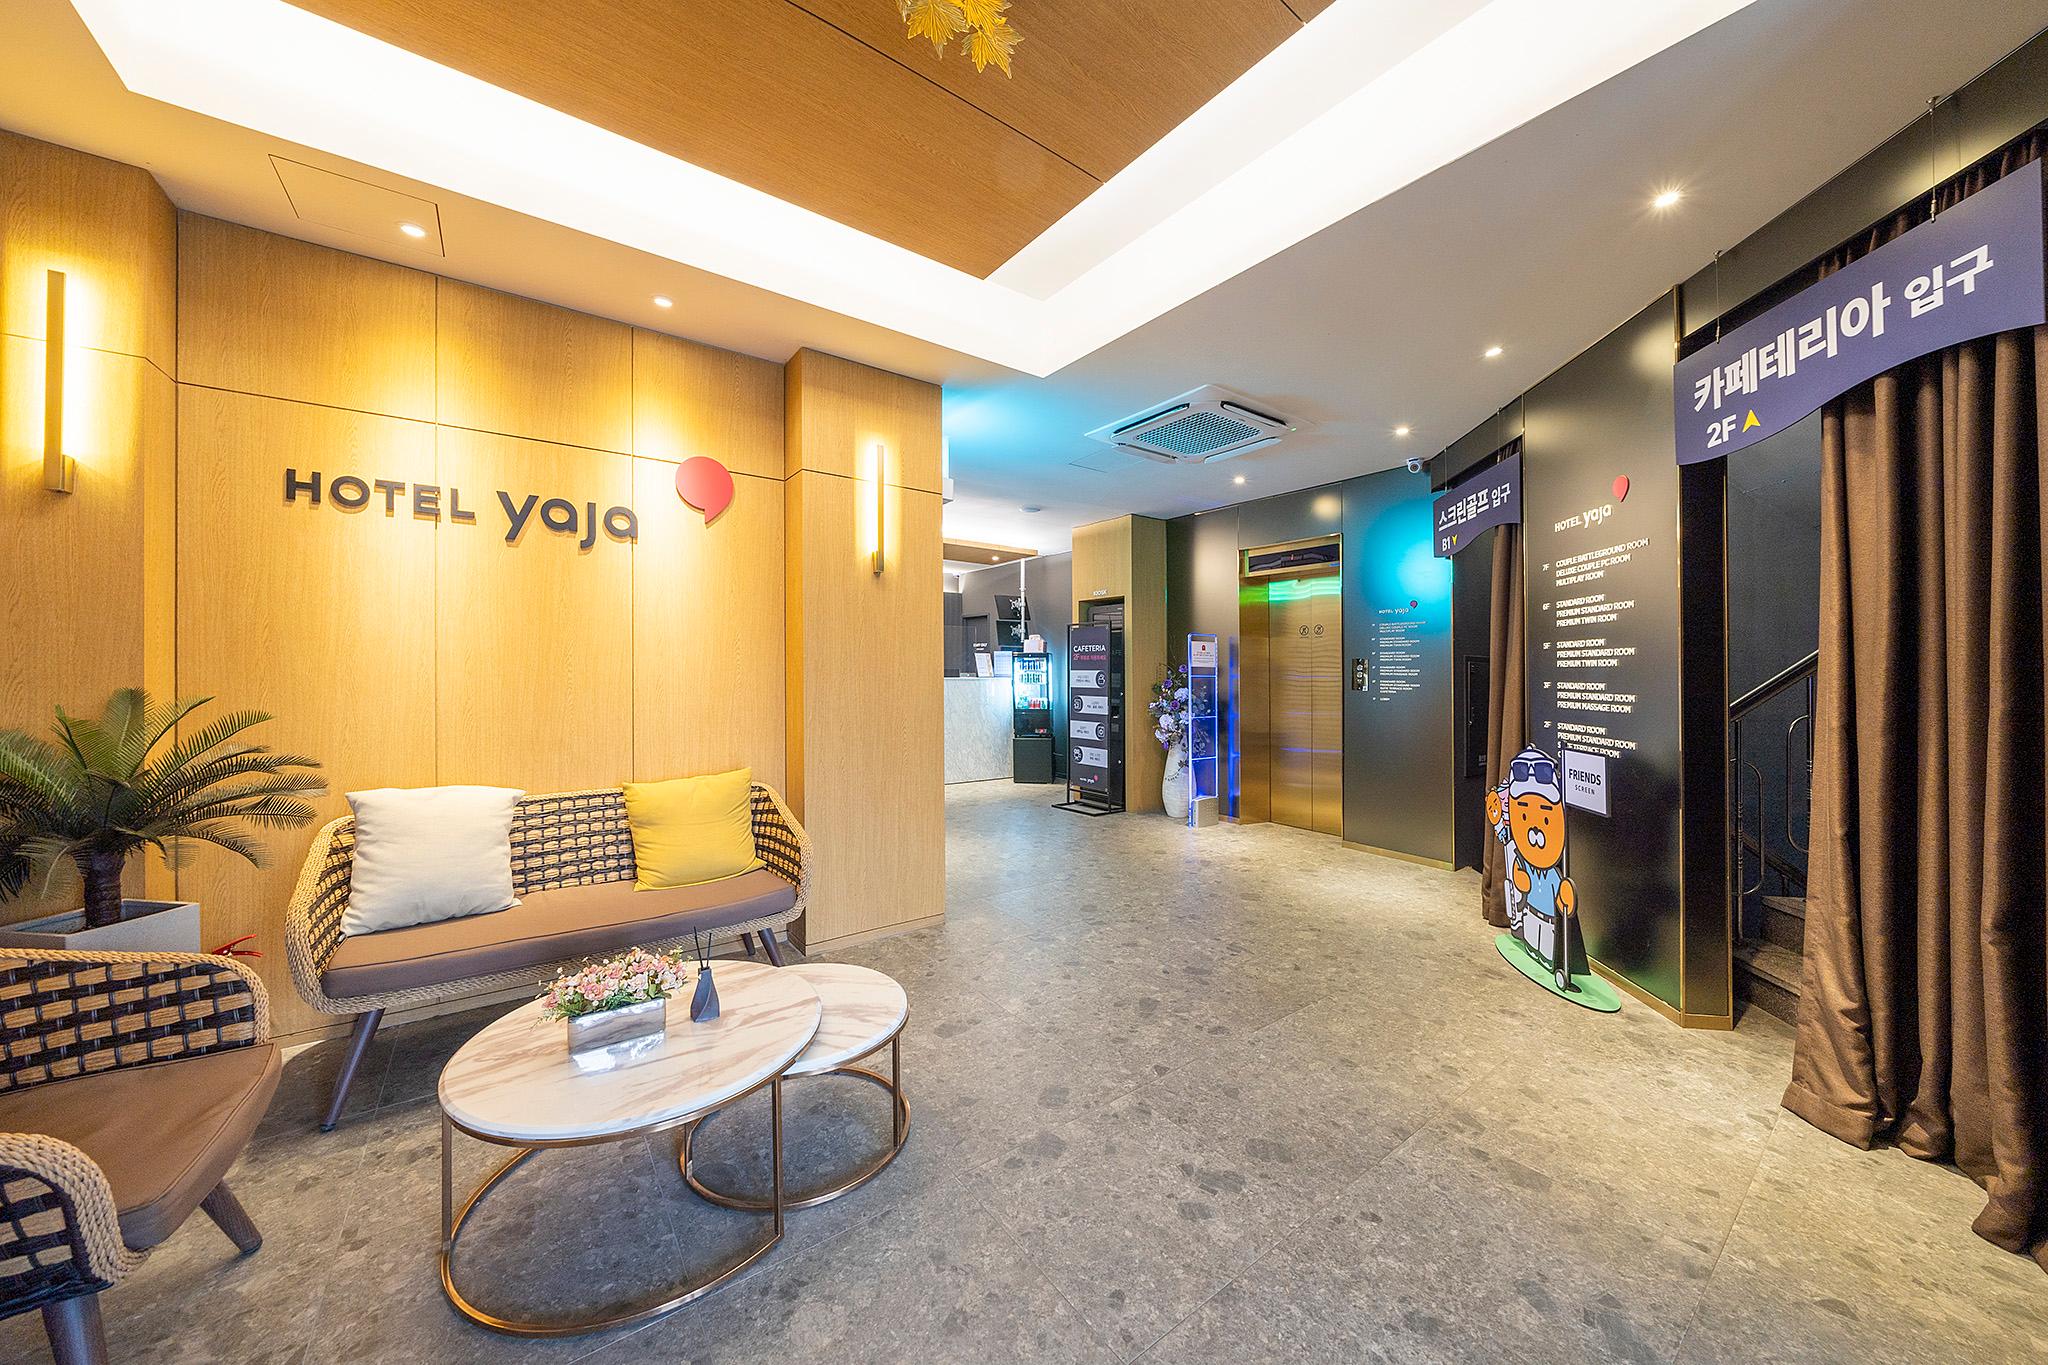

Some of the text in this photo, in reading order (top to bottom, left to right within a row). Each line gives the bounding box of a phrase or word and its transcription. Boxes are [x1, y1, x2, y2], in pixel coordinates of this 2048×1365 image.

[1693, 244, 1994, 413] 카페테리아 입구
[1706, 414, 1737, 449] 2F
[285, 468, 639, 550] HOTEL yaja
[1438, 482, 1511, 532] 스크린골프 입구
[1554, 504, 1613, 533] HOTEL yaja
[1442, 536, 1451, 552] B1
[1555, 537, 1650, 568] COUPLE BATTLEGROUND ROOM
[1555, 567, 1578, 578] DELUXE
[1577, 561, 1601, 574] COUPLE
[1610, 553, 1632, 566] ROOM
[1585, 570, 1605, 581] ROOM
[1556, 594, 1606, 609] STANDARD ROOM
[1556, 600, 1635, 618] PREMIUM STANDARD ROOM
[1556, 613, 1618, 627] PREMIUM TWIN ROOM
[1073, 644, 1106, 653] CAFETERIA
[1556, 638, 1606, 649] STANDARD ROOM
[1556, 647, 1636, 658] PREMIUM STANDARD ROOM
[1556, 659, 1618, 668] PREMIUM TWIN ROOM
[1556, 681, 1606, 691] STANDARD ROOM
[1556, 691, 1636, 703] PREMIUM STANDARD ROOM
[1556, 701, 1632, 713] PREMIUM MASSAGE ROOM
[1543, 720, 1552, 728] 2F
[1556, 722, 1606, 735] STANDARD ROOM
[1557, 731, 1637, 751] PREMIUM STANDARD ROOM
[1599, 748, 1621, 758] ROOM
[1568, 768, 1602, 786] FRIENDS
[1574, 784, 1595, 795] SCREEN
